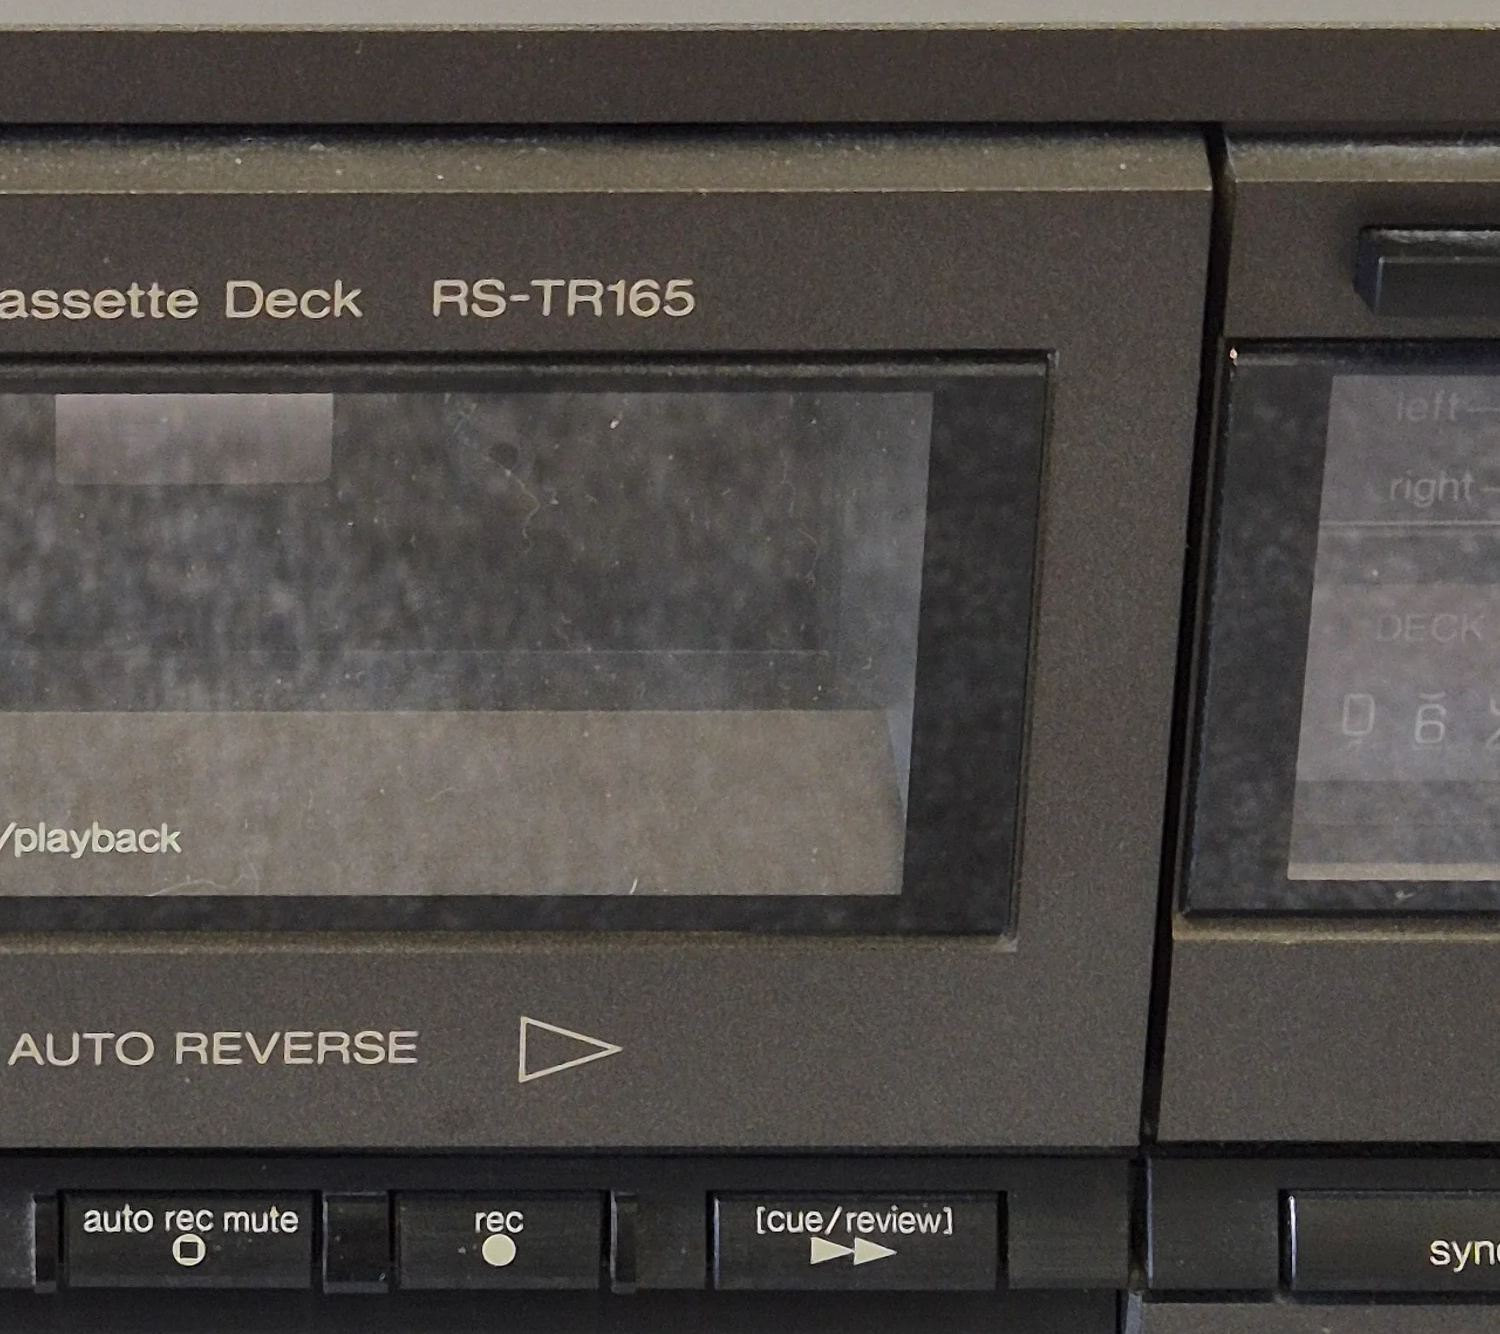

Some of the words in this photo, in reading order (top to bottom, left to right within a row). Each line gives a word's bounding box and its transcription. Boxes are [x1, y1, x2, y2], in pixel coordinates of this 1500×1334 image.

[225, 279, 363, 319] Deck
[432, 278, 695, 318] RS-TR165
[1396, 389, 1460, 423] left
[1389, 468, 1475, 508] right
[1374, 613, 1483, 644] DECK
[7, 1031, 155, 1066] AUTO
[175, 1030, 418, 1065] REVERSE
[83, 1203, 154, 1233] auto
[165, 1209, 214, 1232] rec
[223, 1206, 299, 1233] mute
[475, 1211, 524, 1233] rec
[756, 1205, 953, 1235] [cue/review]
[1429, 1240, 1500, 1273] syn
